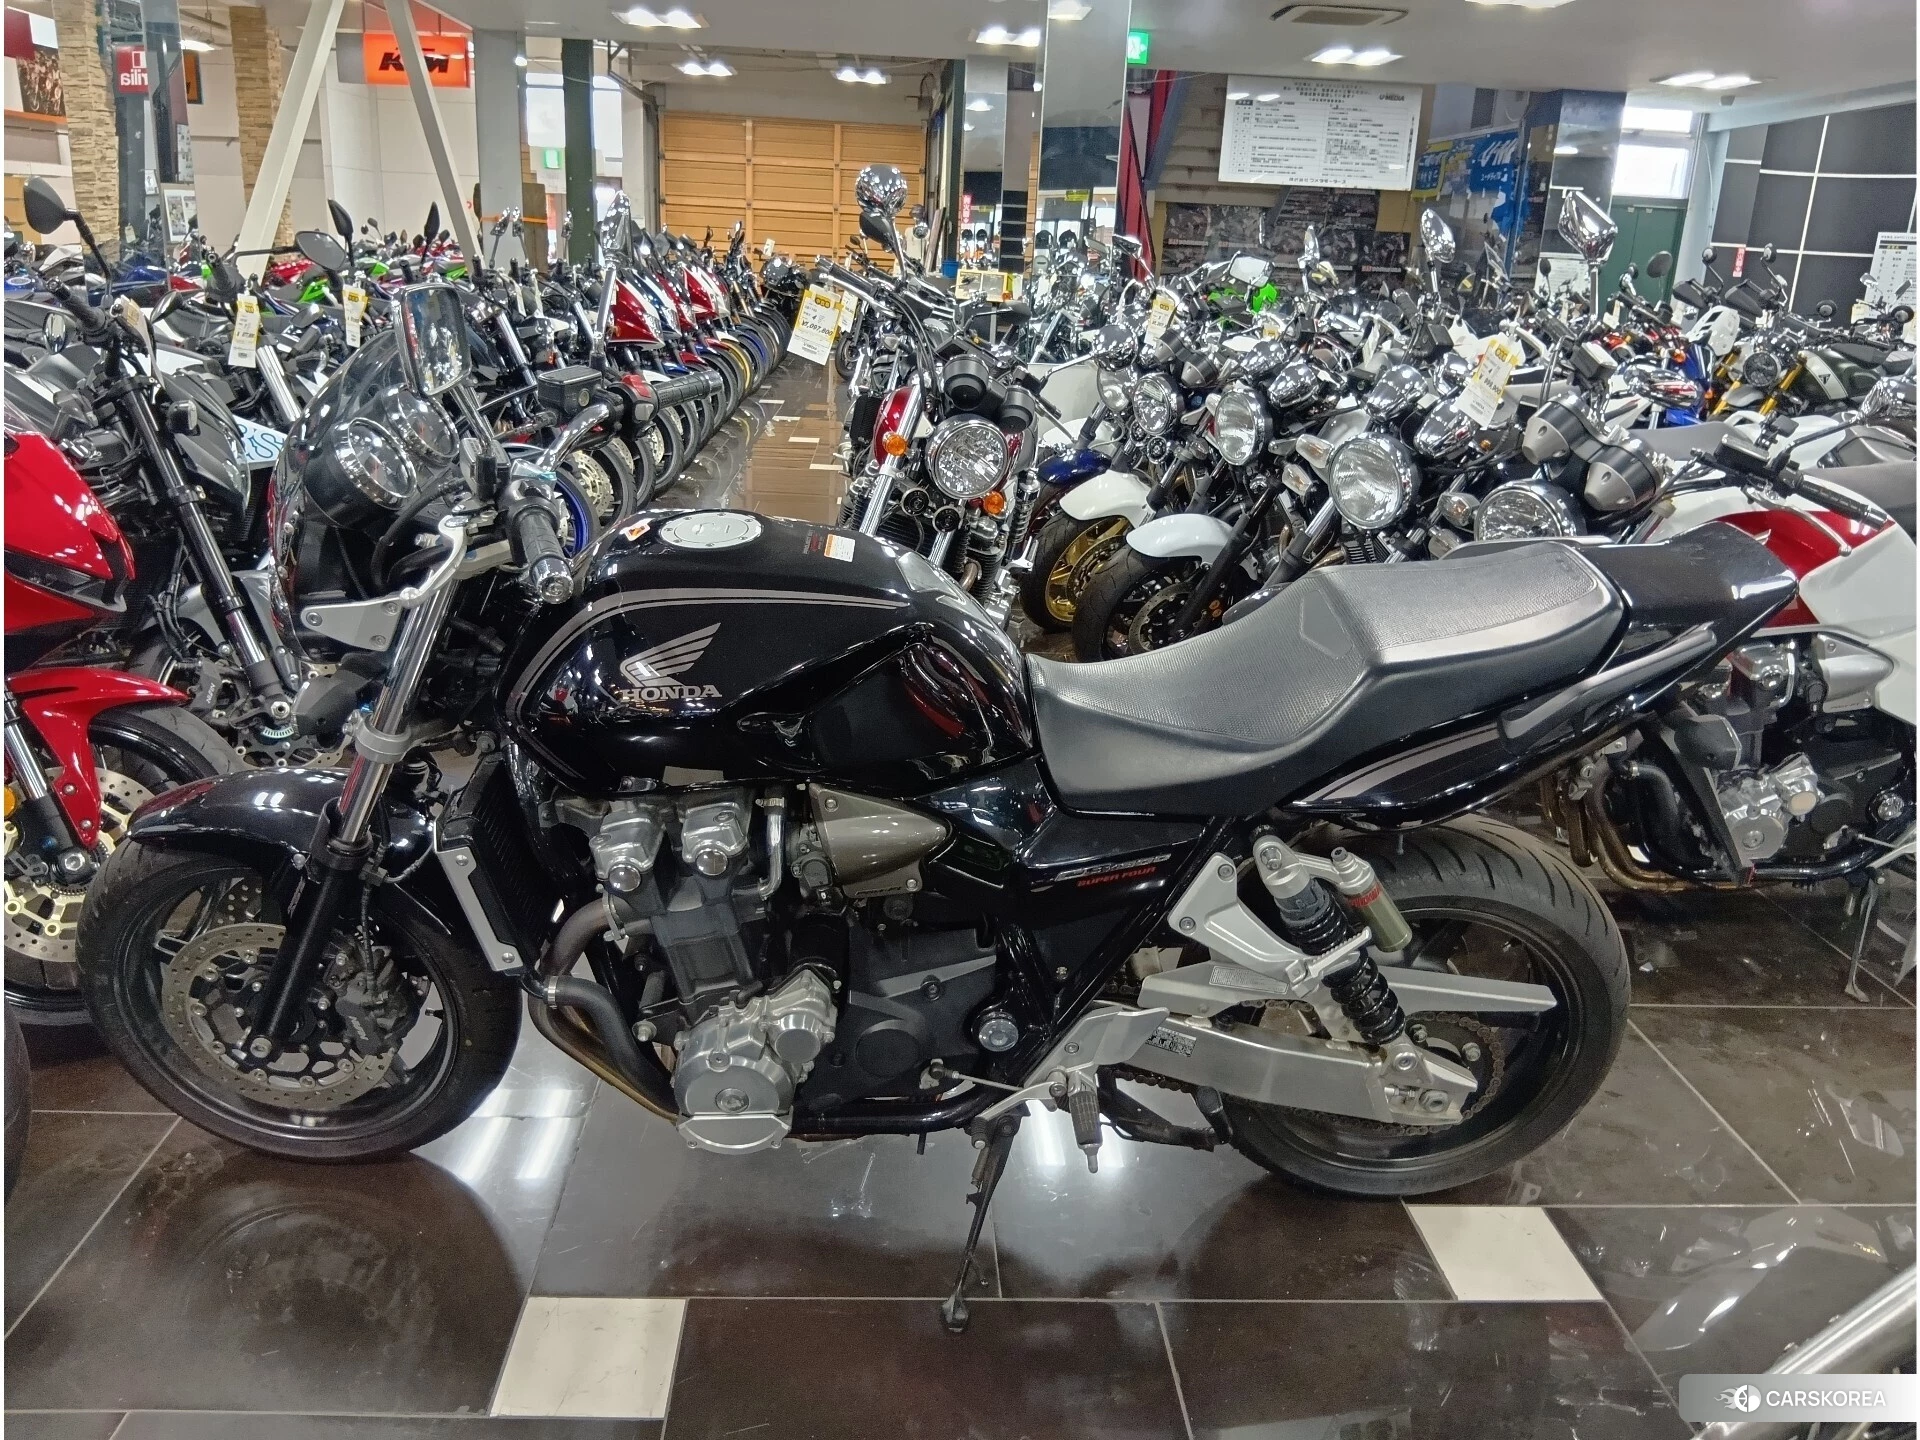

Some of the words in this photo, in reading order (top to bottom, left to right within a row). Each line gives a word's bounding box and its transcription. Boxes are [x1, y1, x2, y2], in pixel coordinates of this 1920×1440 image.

[620, 685, 723, 702] HONDA
[1077, 873, 1119, 887] SUPER
[1121, 866, 1157, 878] FOUR
